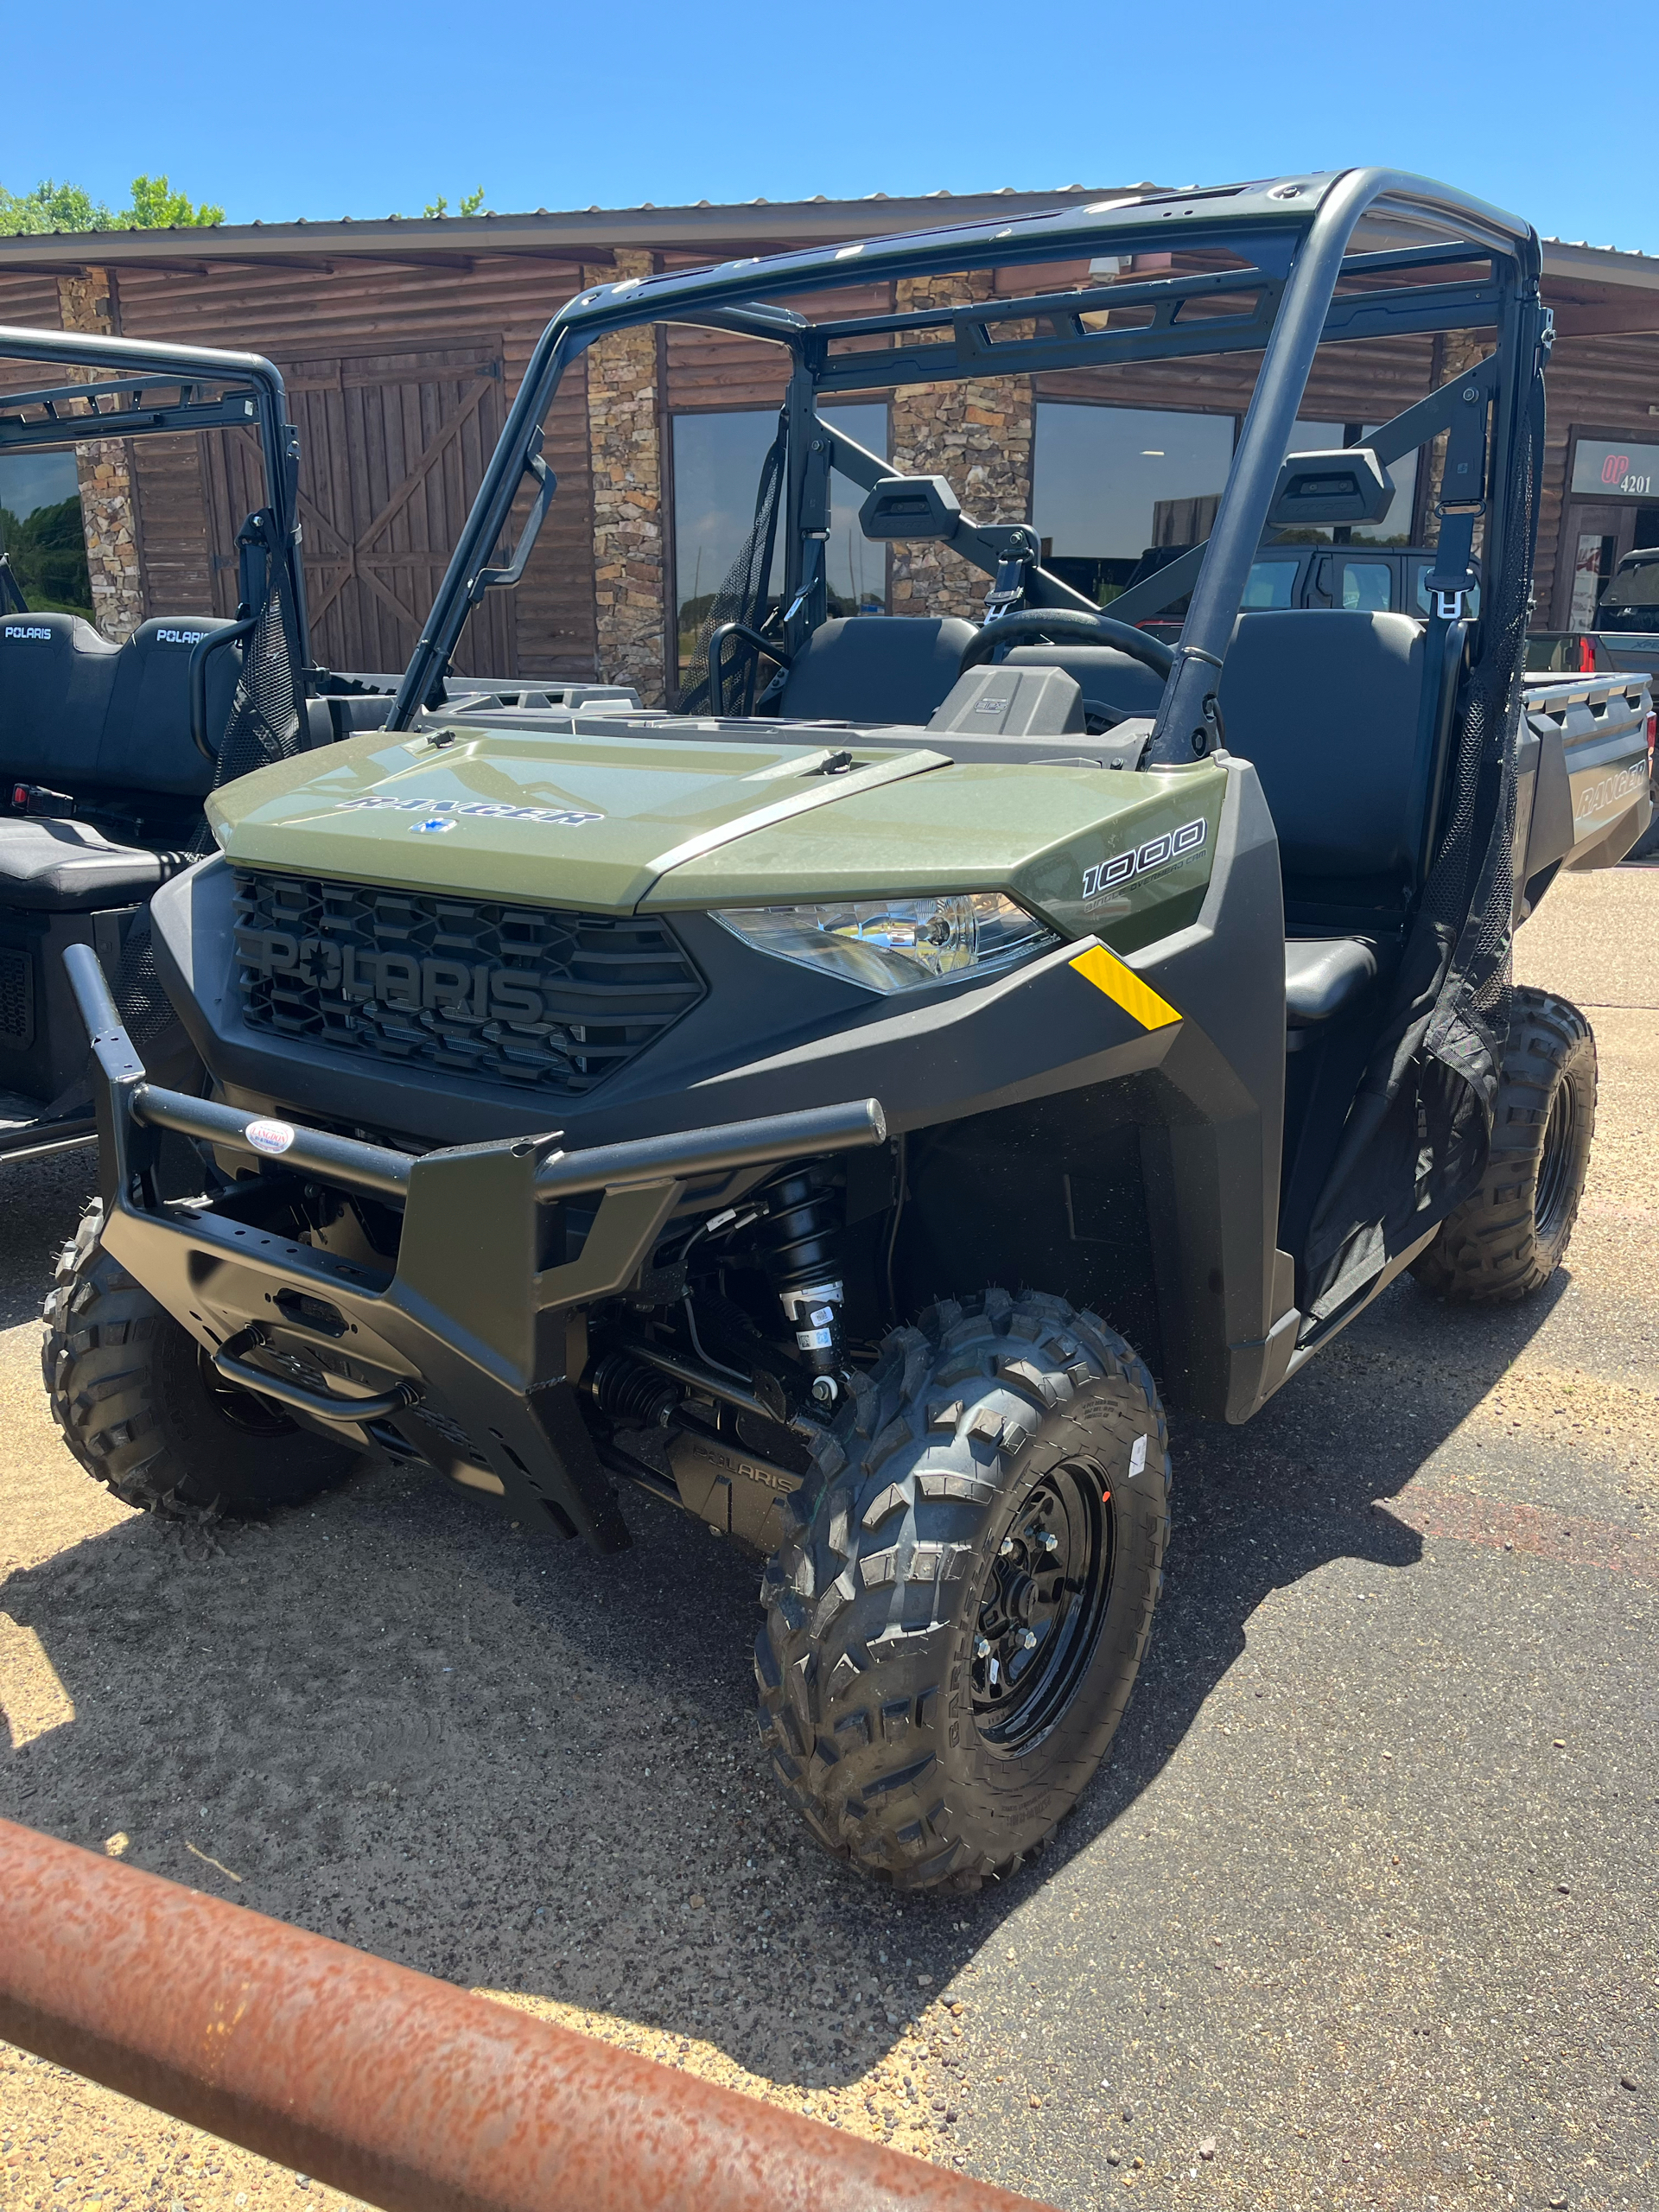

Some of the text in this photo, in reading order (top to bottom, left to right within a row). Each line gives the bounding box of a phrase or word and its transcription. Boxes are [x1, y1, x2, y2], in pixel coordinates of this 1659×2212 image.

[1620, 475, 1650, 493] 4201
[5, 626, 52, 640] POLARIS
[335, 796, 605, 828] RANGER
[1575, 759, 1646, 821] RANGER
[1082, 817, 1208, 899] 1000
[1084, 850, 1207, 911] SINGLE OVERHEAD CAM
[259, 929, 546, 1025] POLARIS
[251, 1127, 286, 1143] LANGDON
[692, 1445, 793, 1494] POLARIS
